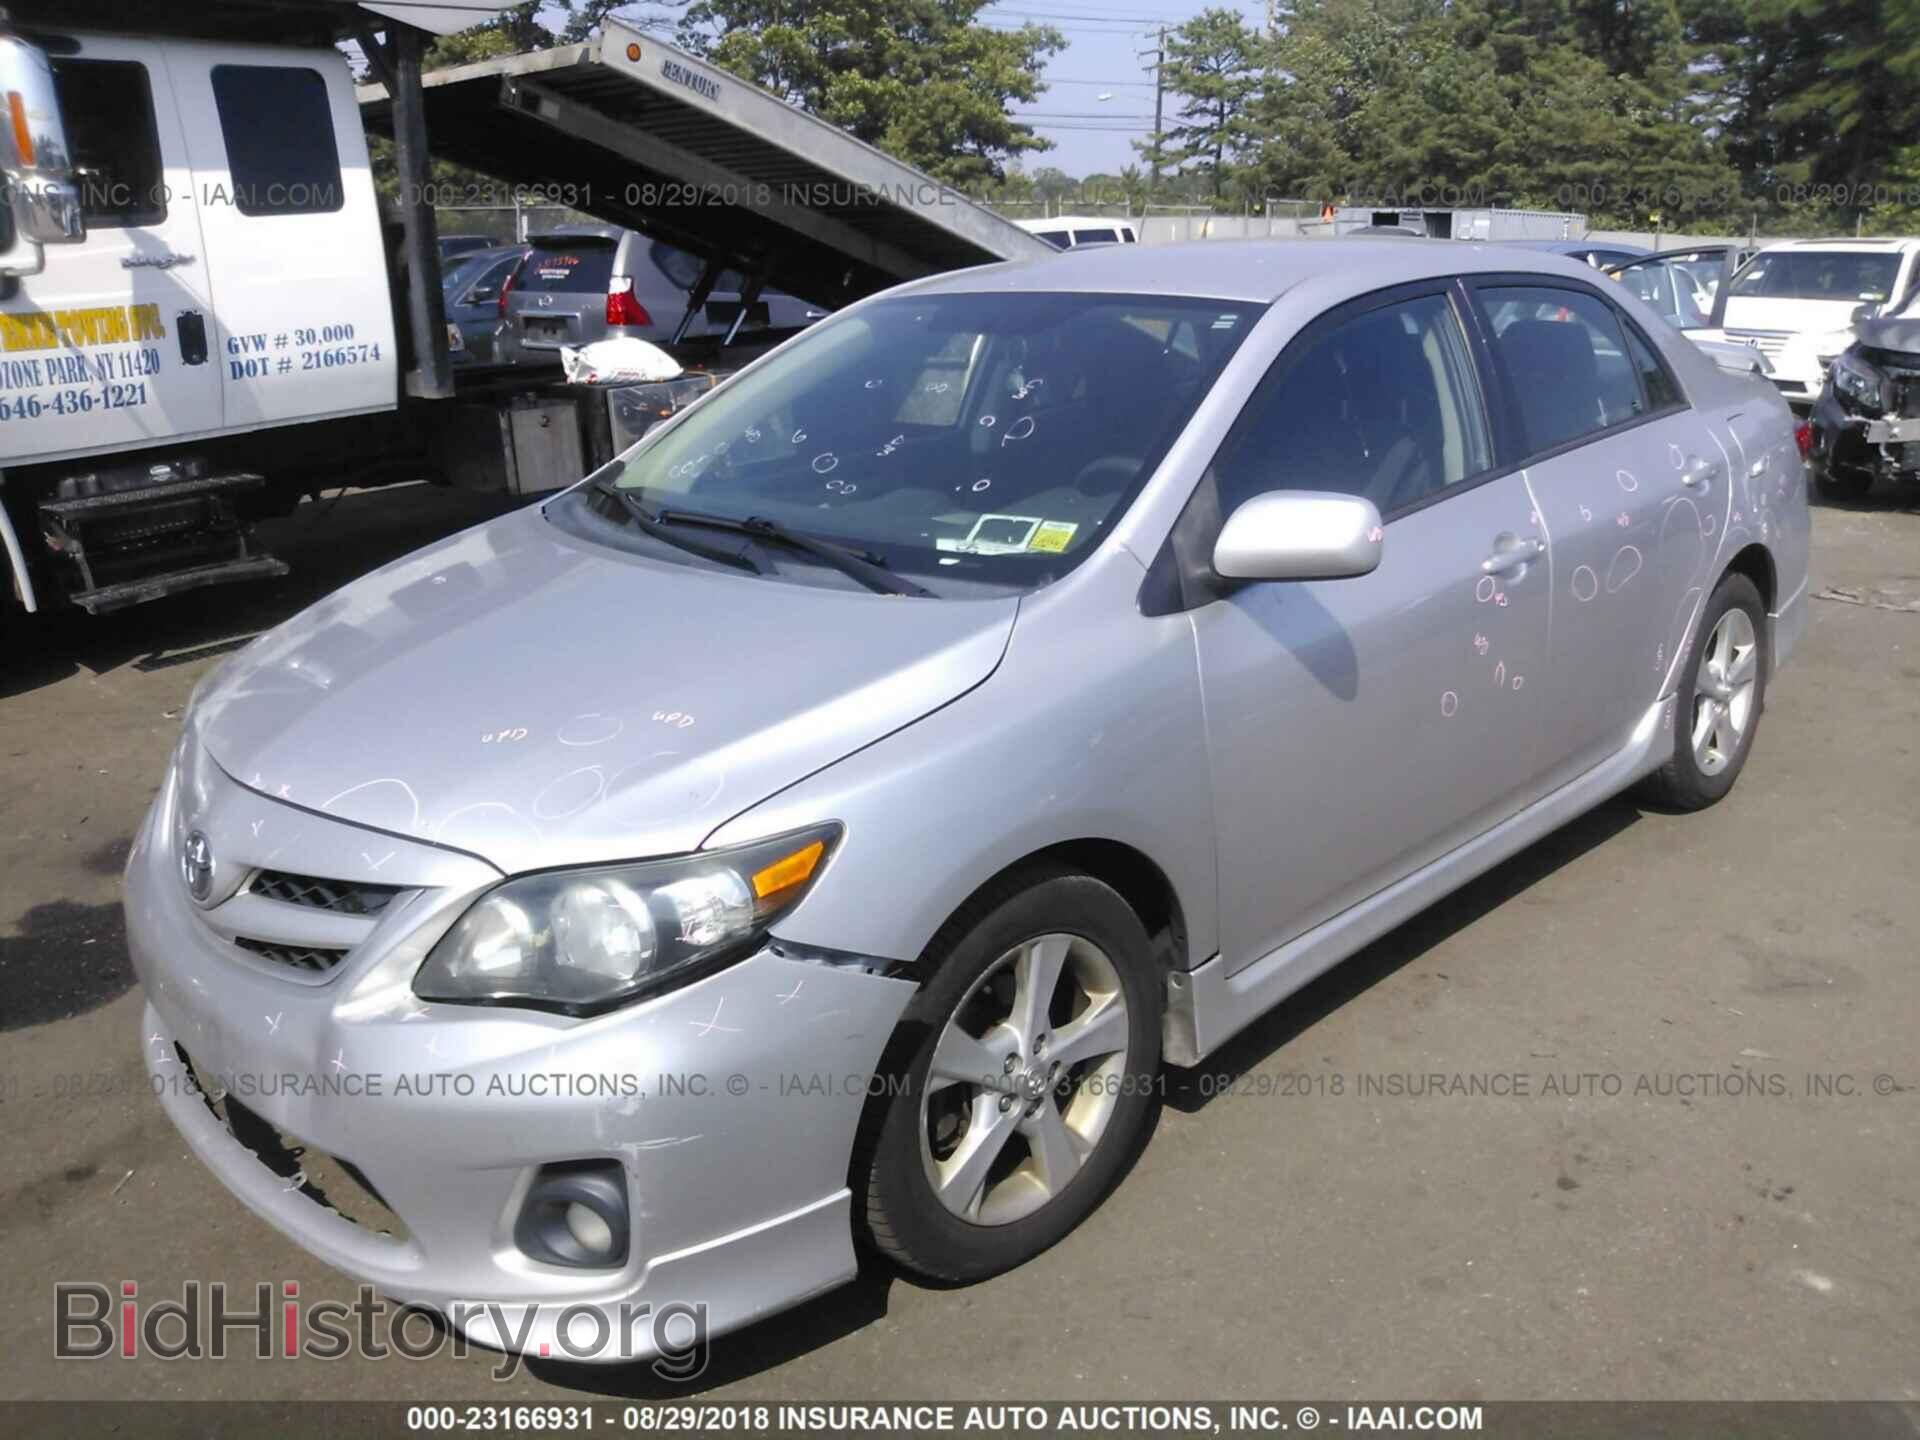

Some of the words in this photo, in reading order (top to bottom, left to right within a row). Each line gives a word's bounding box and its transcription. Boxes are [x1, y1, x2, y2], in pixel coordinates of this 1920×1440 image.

[227, 333, 267, 355] GVW
[274, 333, 289, 349] #
[230, 356, 270, 381] DOT
[277, 356, 293, 374] #
[301, 343, 382, 371] 2166574
[45, 353, 94, 386] PARK,
[96, 352, 116, 382] NY
[119, 348, 161, 379] 11420
[0, 382, 148, 421] 646-436-1221
